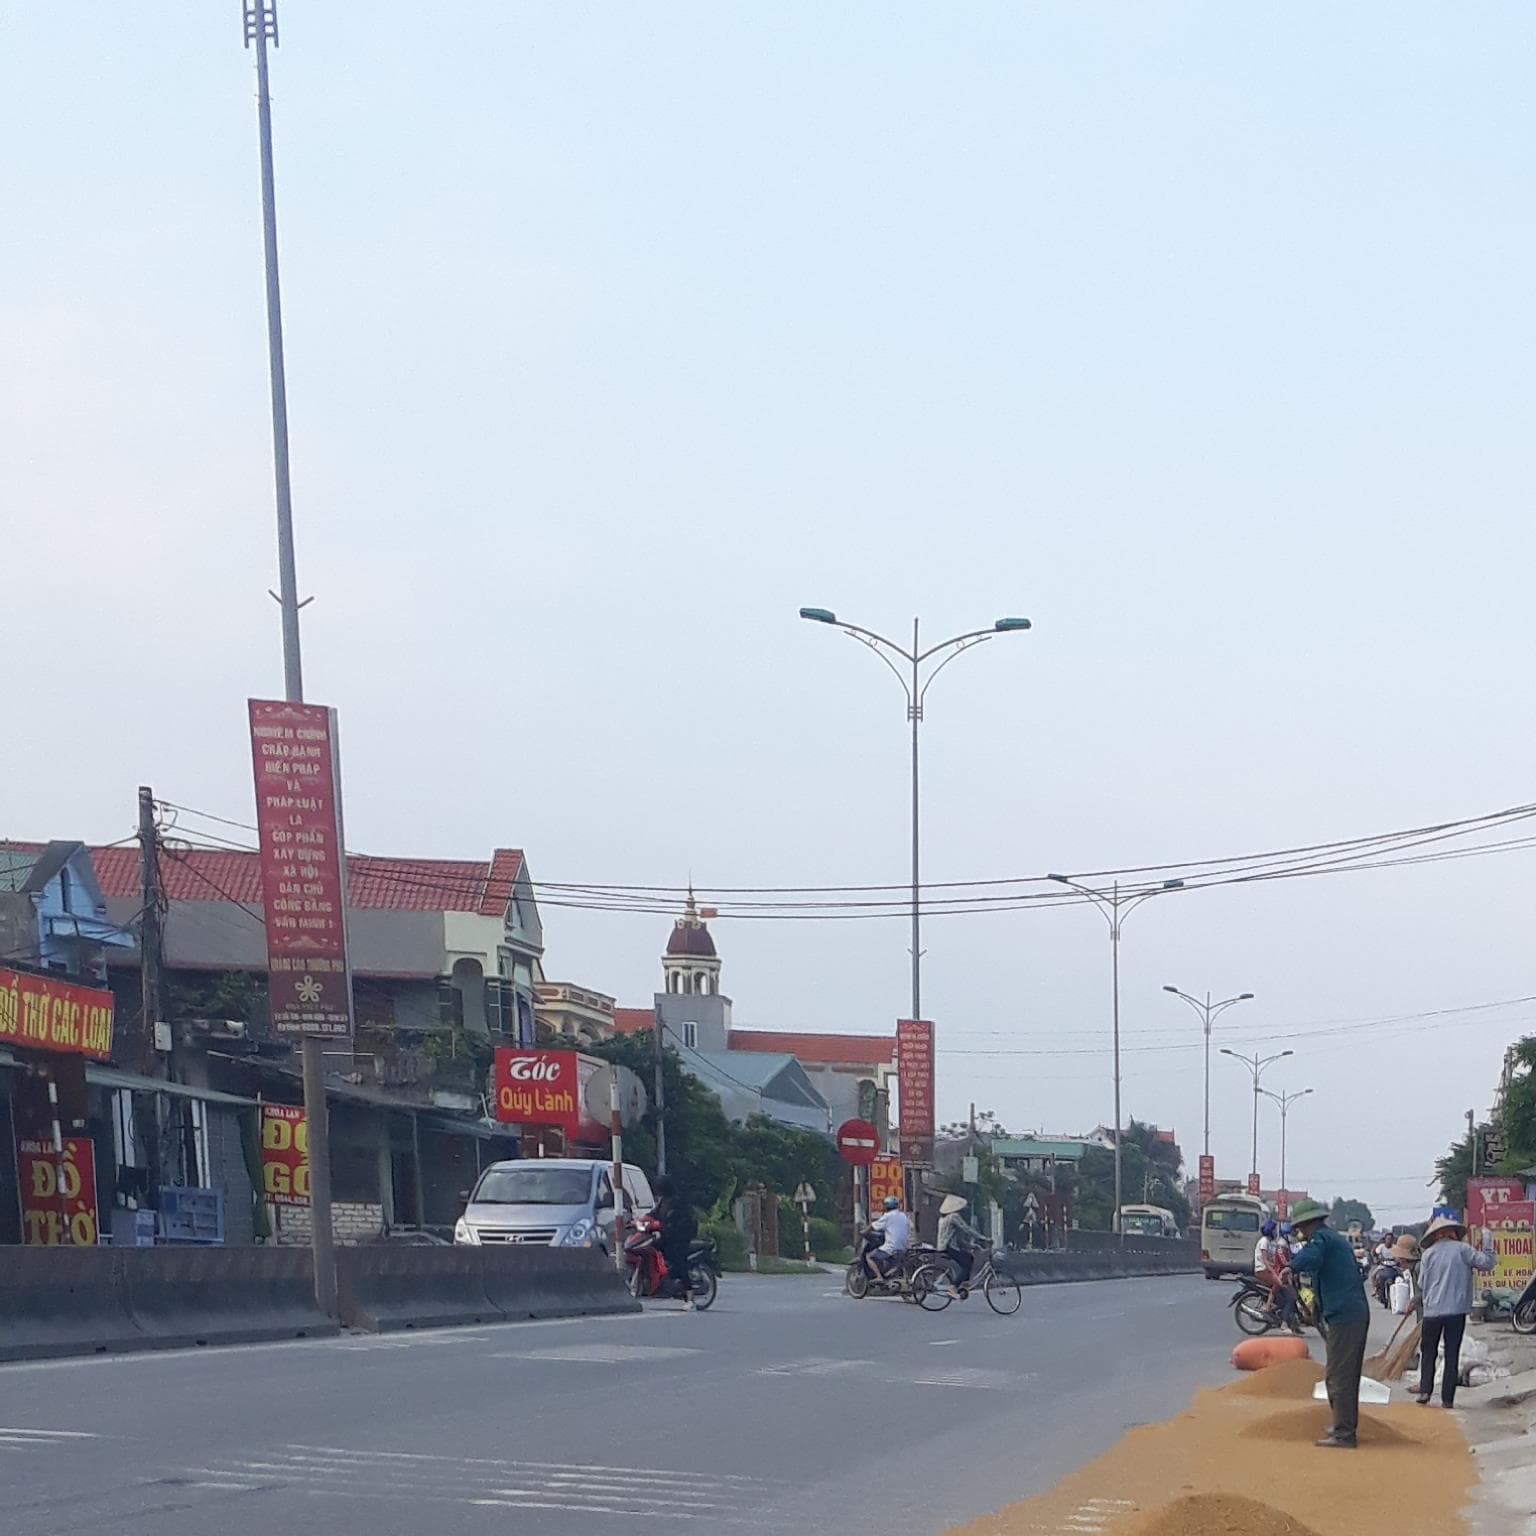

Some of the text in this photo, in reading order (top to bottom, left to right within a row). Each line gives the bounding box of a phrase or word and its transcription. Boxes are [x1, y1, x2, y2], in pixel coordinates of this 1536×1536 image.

[23, 983, 50, 1041] THỜ
[51, 991, 79, 1046] CÁC
[82, 1004, 112, 1058] LOẠI
[535, 1087, 574, 1112] Lành
